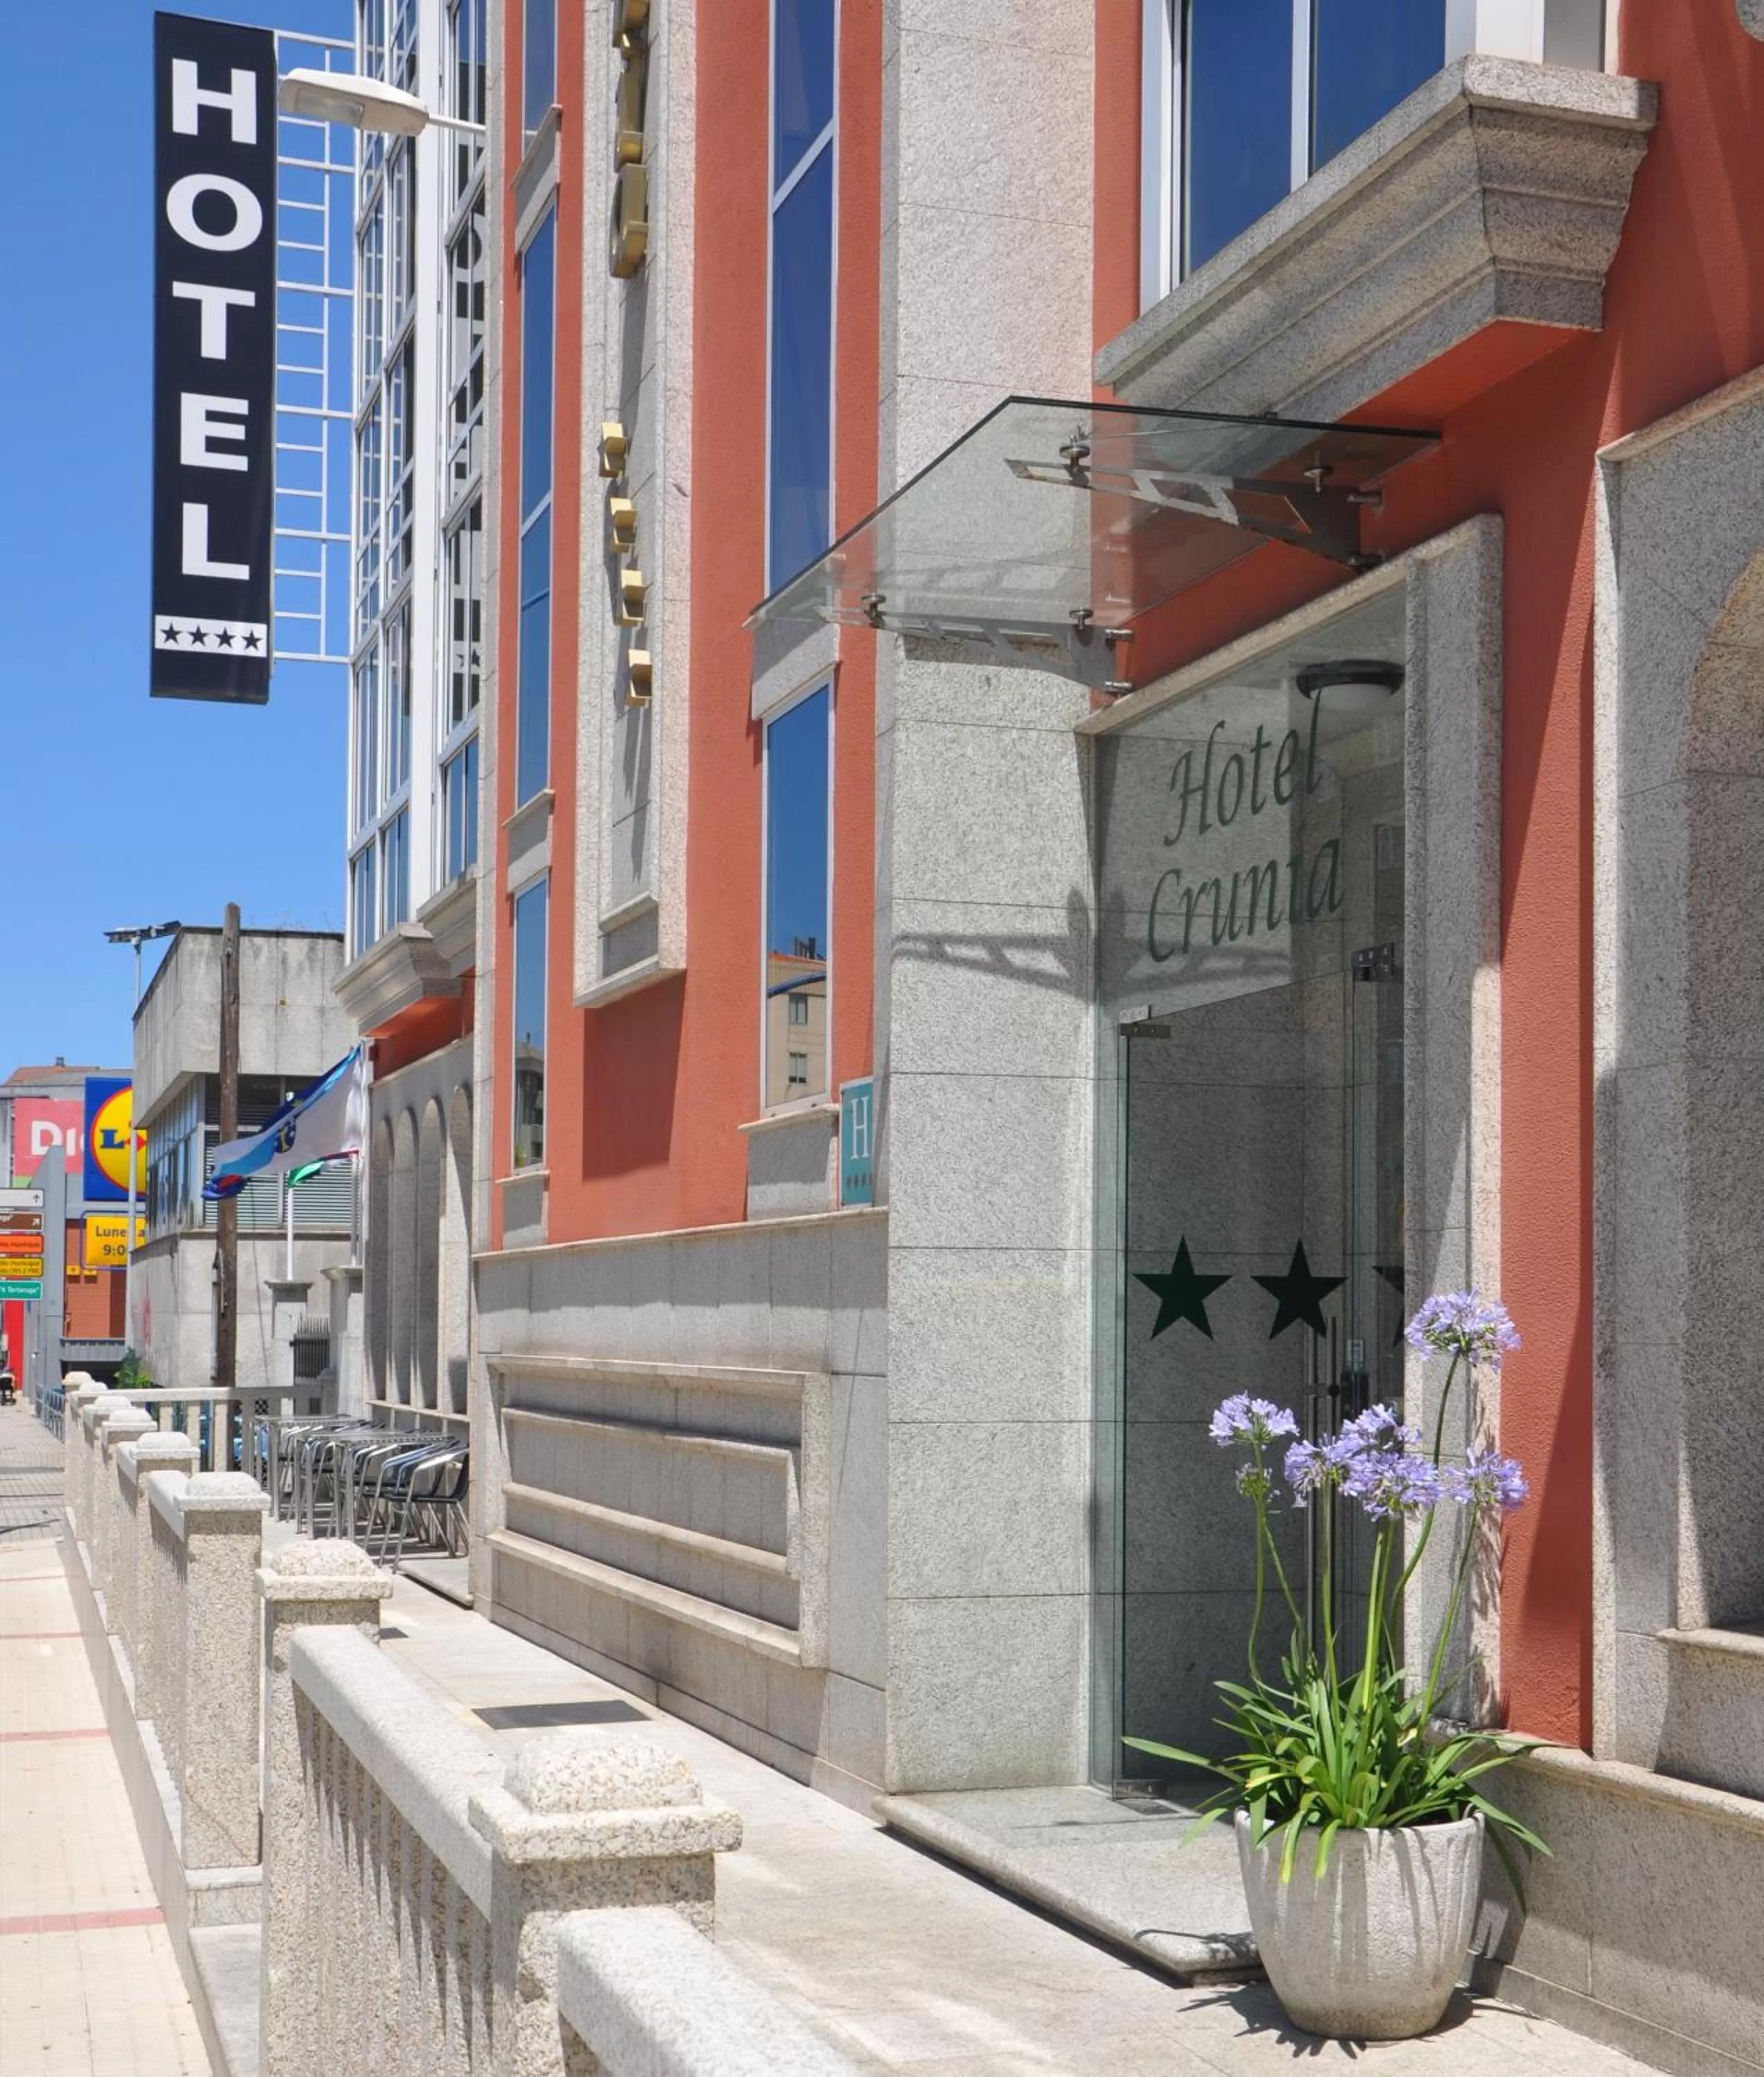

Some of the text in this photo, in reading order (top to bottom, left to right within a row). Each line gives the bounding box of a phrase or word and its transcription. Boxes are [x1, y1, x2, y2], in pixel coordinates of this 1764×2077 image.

[166, 58, 263, 581] HOTEL
[1163, 684, 1322, 847] Hotel
[851, 1096, 870, 1160] H
[96, 1225, 128, 1237] Lune
